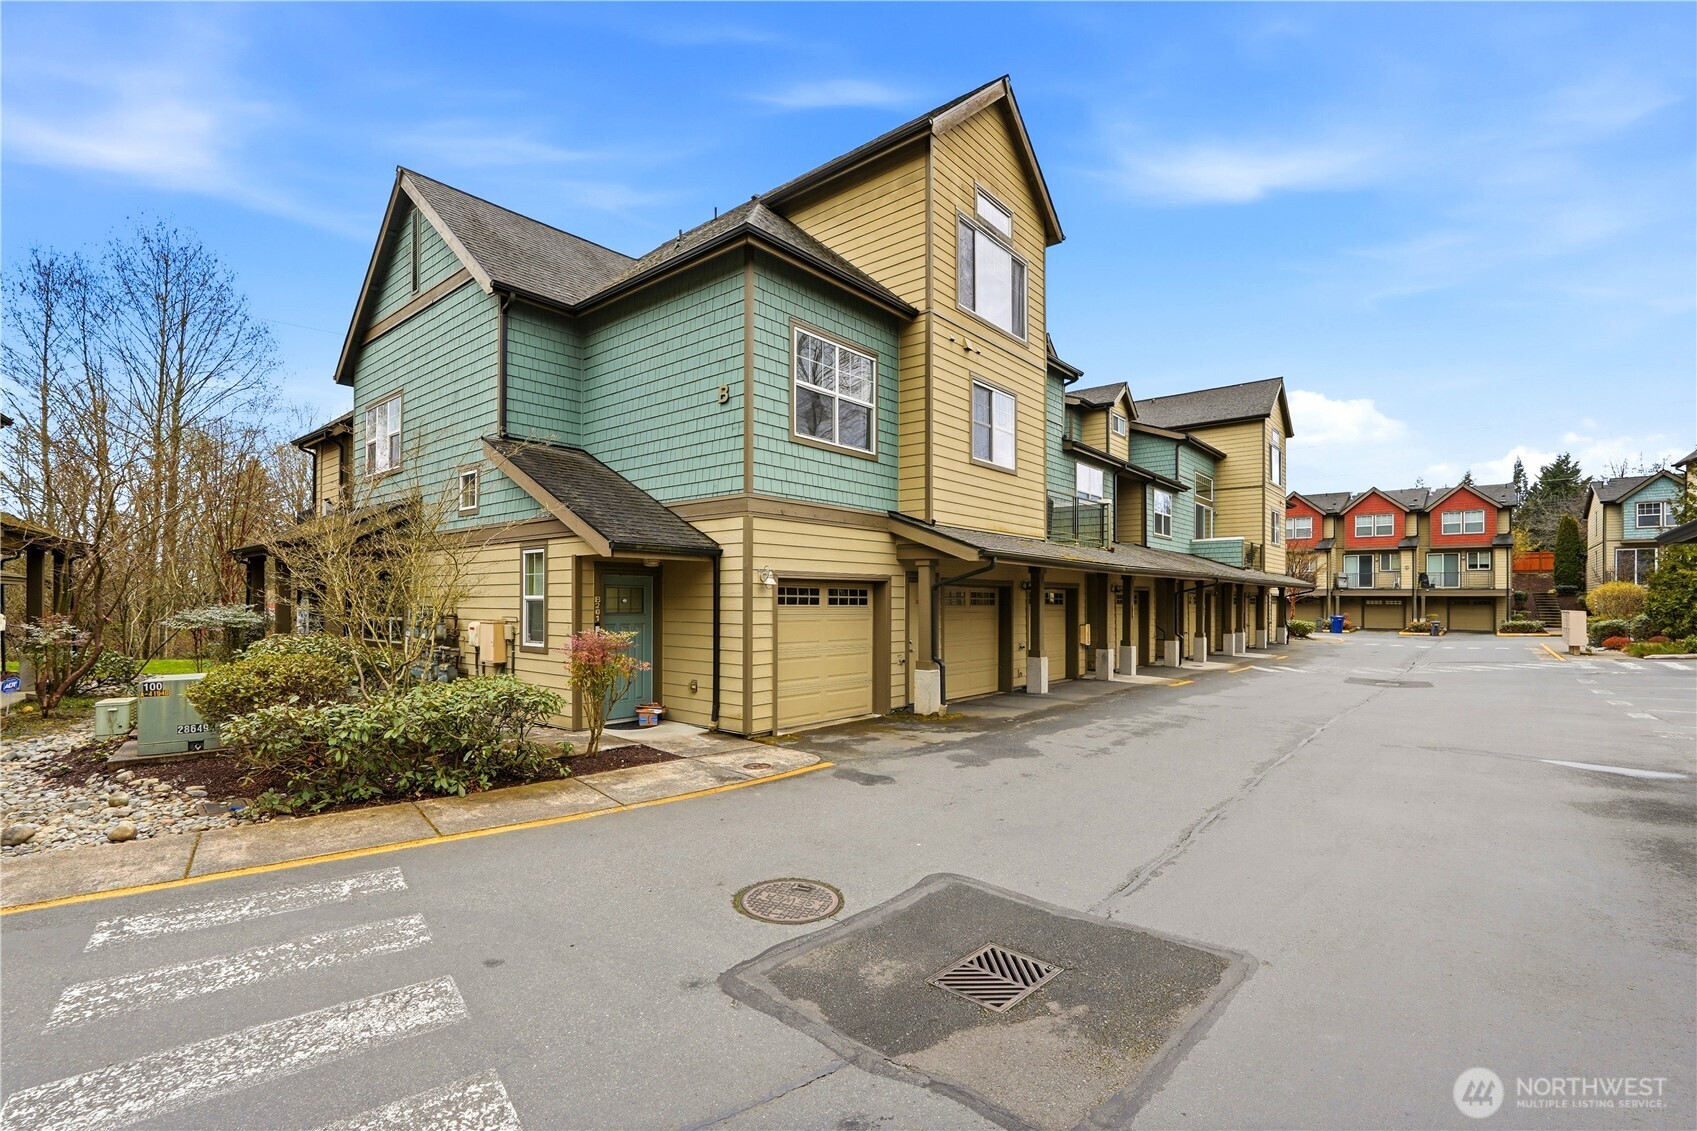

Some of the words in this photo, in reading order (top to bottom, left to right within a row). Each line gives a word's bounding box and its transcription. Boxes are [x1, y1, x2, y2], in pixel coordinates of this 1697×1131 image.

[718, 384, 729, 403] B
[3, 681, 18, 691] ADT
[143, 682, 163, 691] 100
[177, 723, 215, 734] 28649
[765, 893, 815, 907] SEWER
